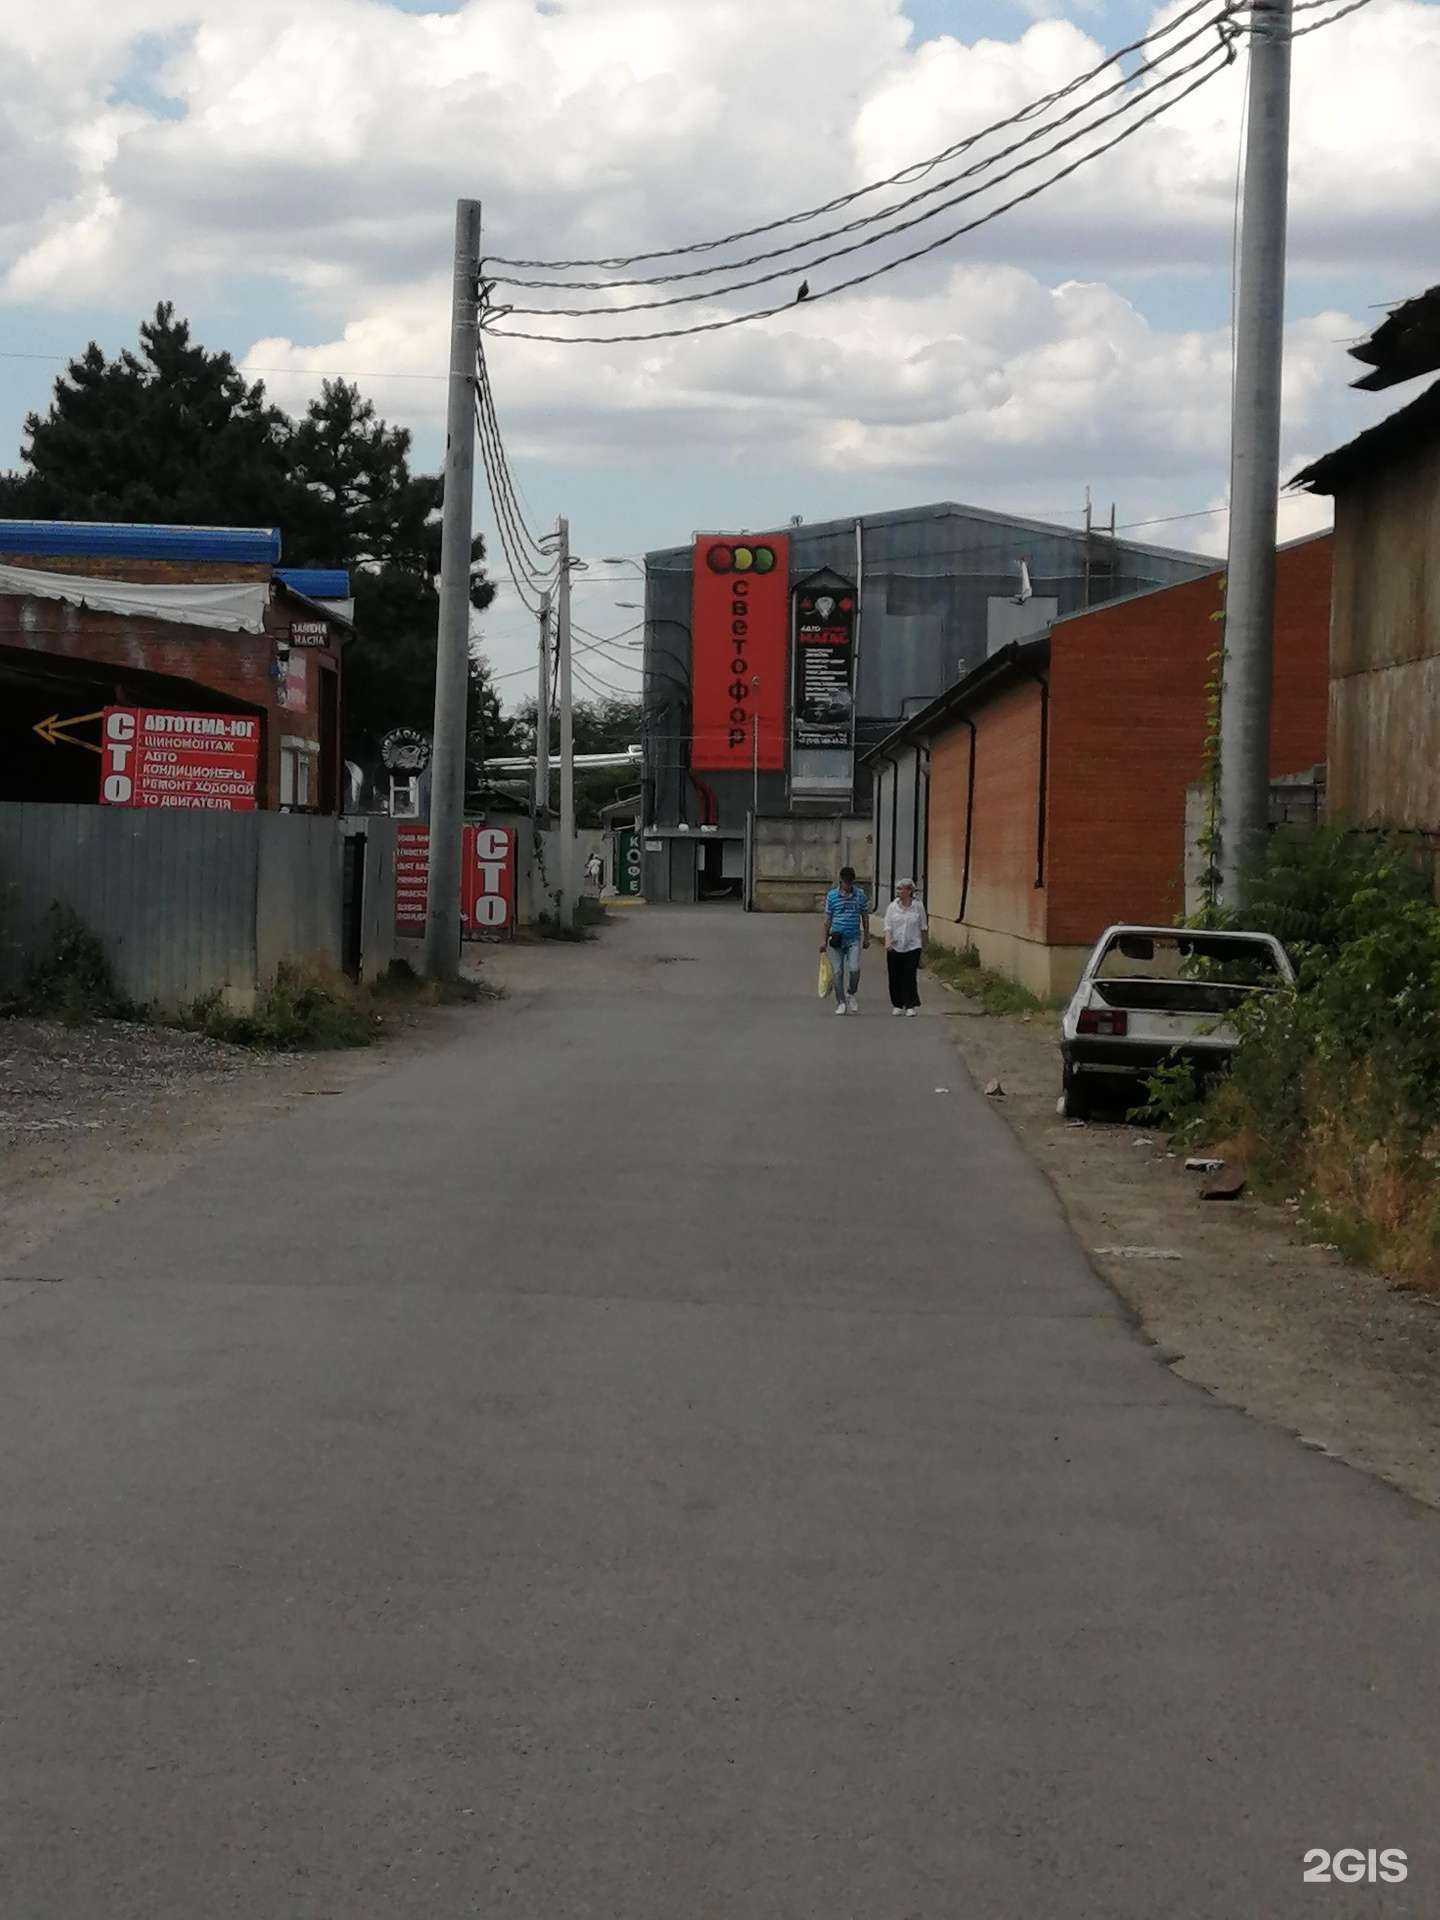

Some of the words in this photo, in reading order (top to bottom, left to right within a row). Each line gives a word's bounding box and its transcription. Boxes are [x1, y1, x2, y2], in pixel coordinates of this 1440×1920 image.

[144, 737, 235, 751] ШИНОМОНТАЖ
[104, 713, 135, 803] СТО
[144, 752, 178, 763] АВТО
[143, 764, 246, 779] КОНДИЦИОНЕРЫ
[142, 778, 192, 791] РЕМОНТ
[195, 780, 255, 795] ХОДОВОЙ
[142, 793, 159, 804] ТО
[161, 796, 231, 810] ДВИГАТЕЛЯ
[475, 828, 509, 926] СТО
